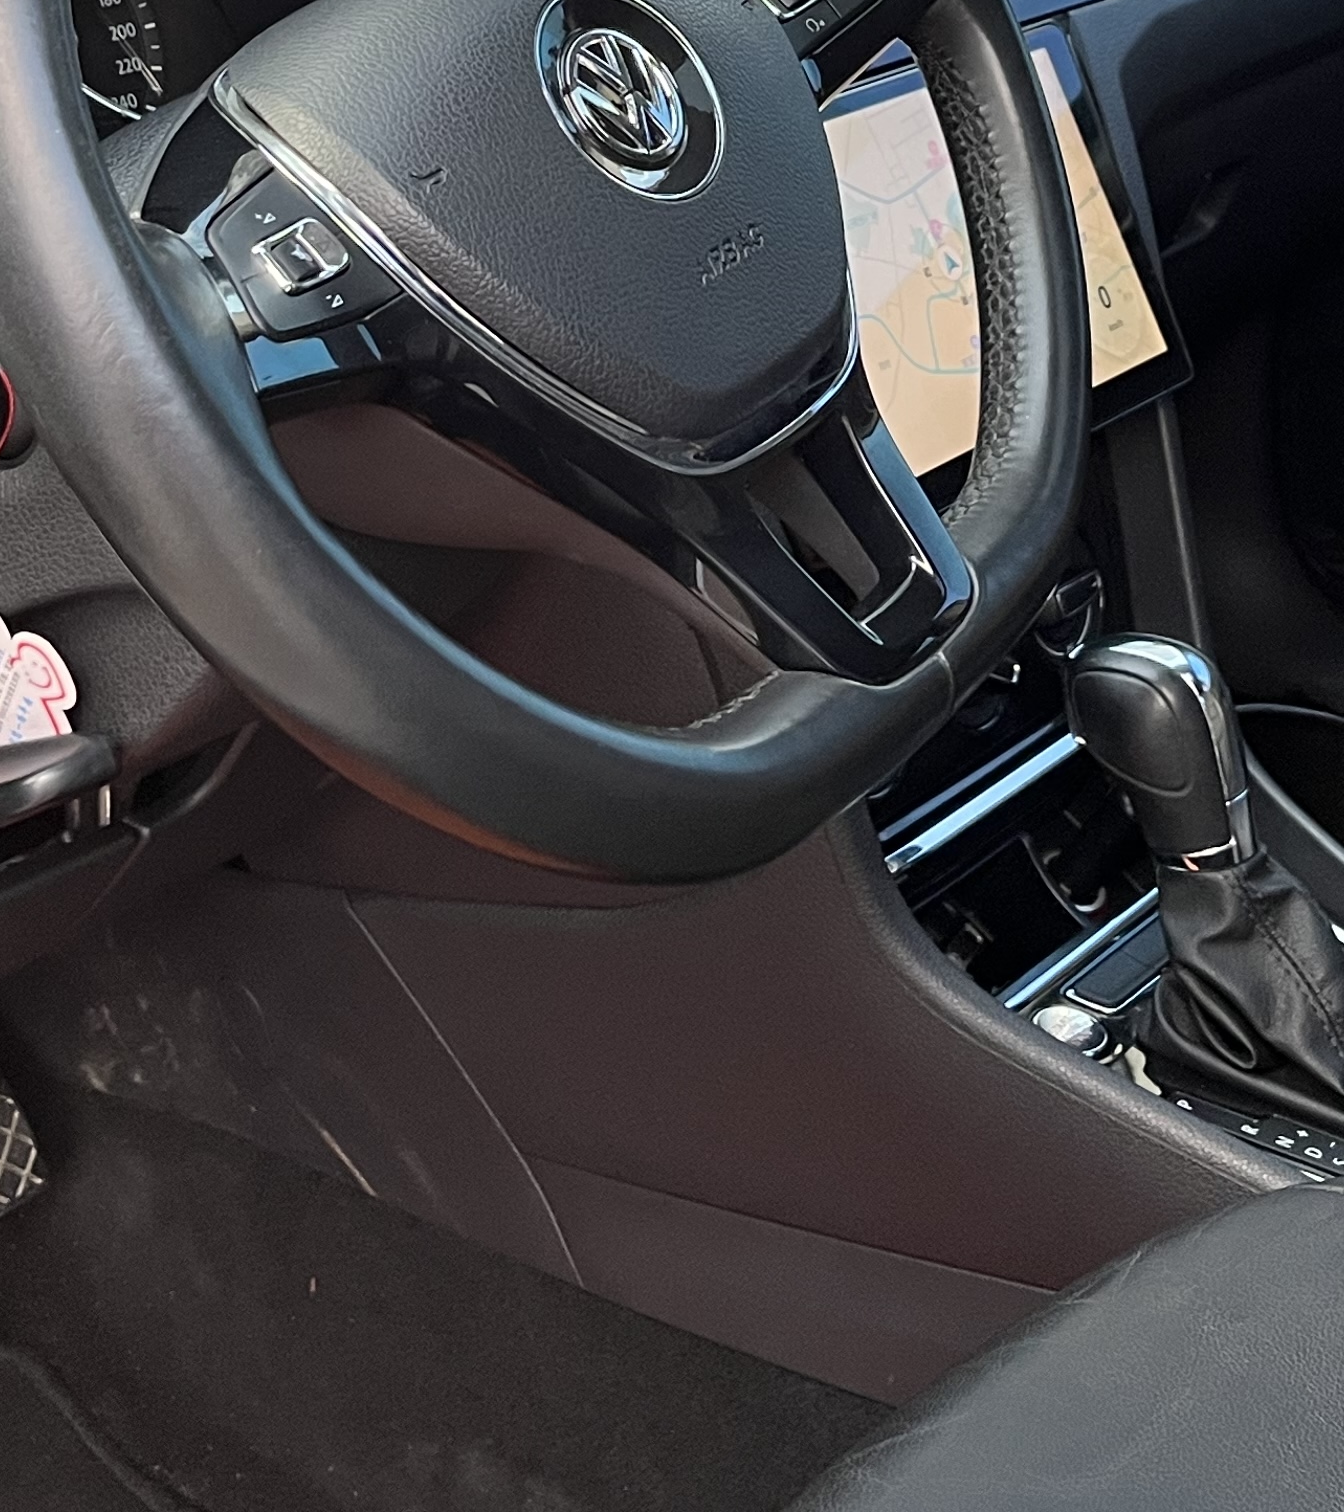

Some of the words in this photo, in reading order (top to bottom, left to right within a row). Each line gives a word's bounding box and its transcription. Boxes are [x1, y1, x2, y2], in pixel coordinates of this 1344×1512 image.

[109, 21, 137, 41] 200
[115, 56, 143, 76] 220
[1176, 1098, 1193, 1111] P
[1240, 1123, 1260, 1136] R
[1274, 1135, 1295, 1150] N
[1303, 1145, 1324, 1159] D
